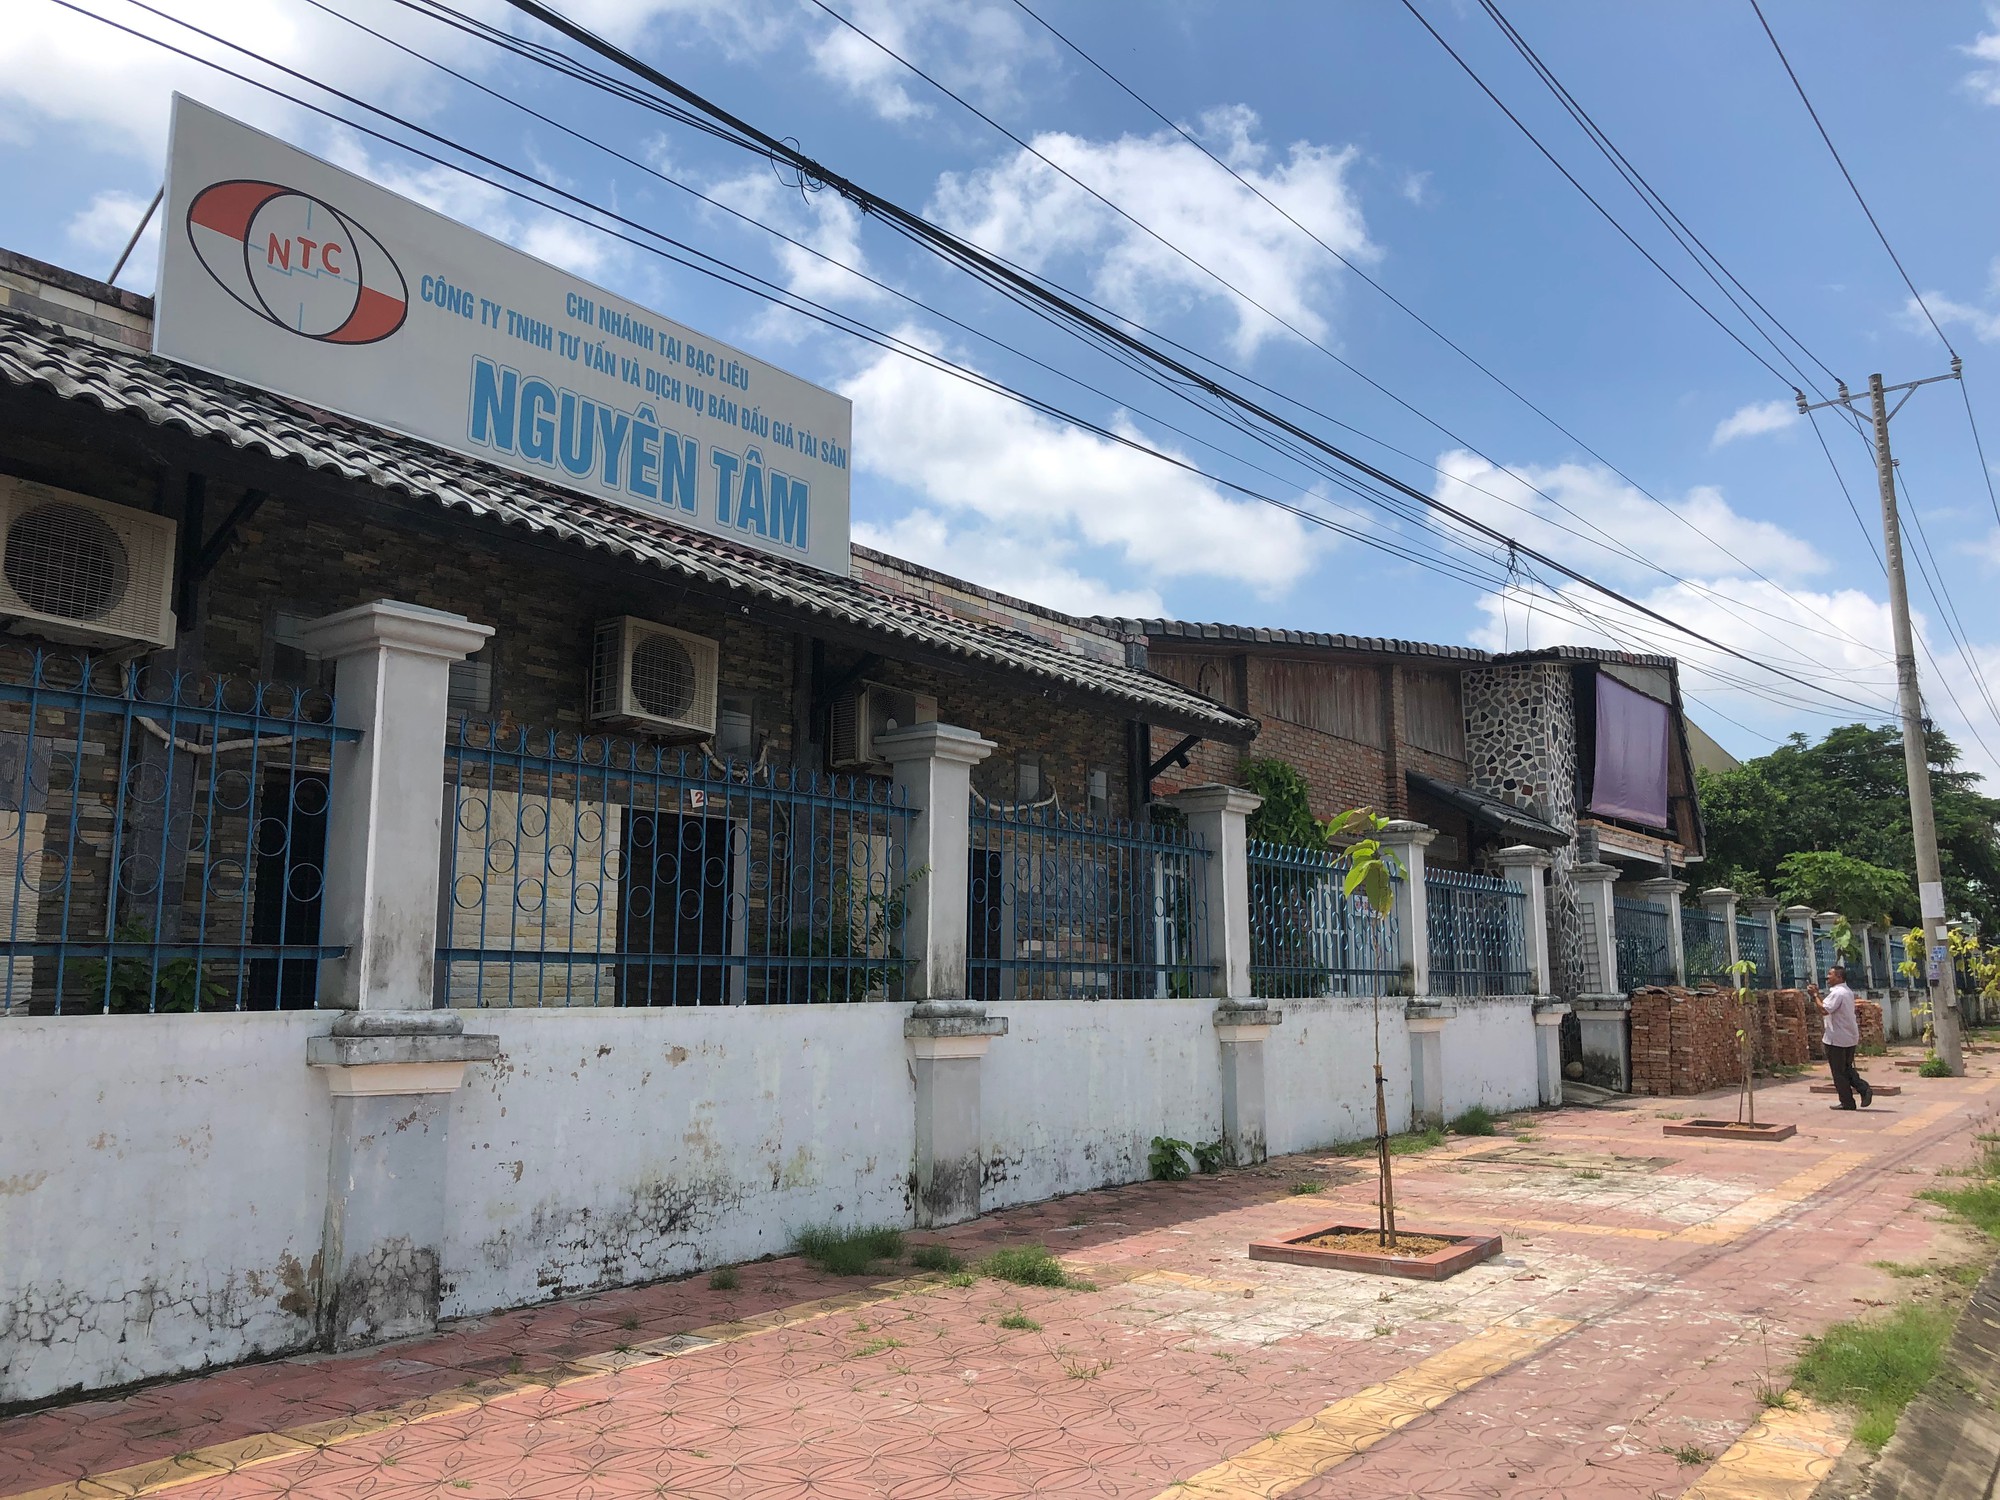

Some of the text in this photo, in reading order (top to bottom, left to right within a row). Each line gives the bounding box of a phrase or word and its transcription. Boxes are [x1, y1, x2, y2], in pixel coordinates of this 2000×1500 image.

[268, 233, 341, 274] NTC
[420, 274, 847, 470] CÔNG TY TNHH TƯ VẤN VÀ DỊCH VỤ BÁN ĐẤU GIÁ TÀI SẢN
[566, 292, 749, 391] CHI NHÁNH TẠI BẠC LIÊU
[470, 357, 810, 551] NGUYÊN TÂM
[695, 791, 704, 803] 2
